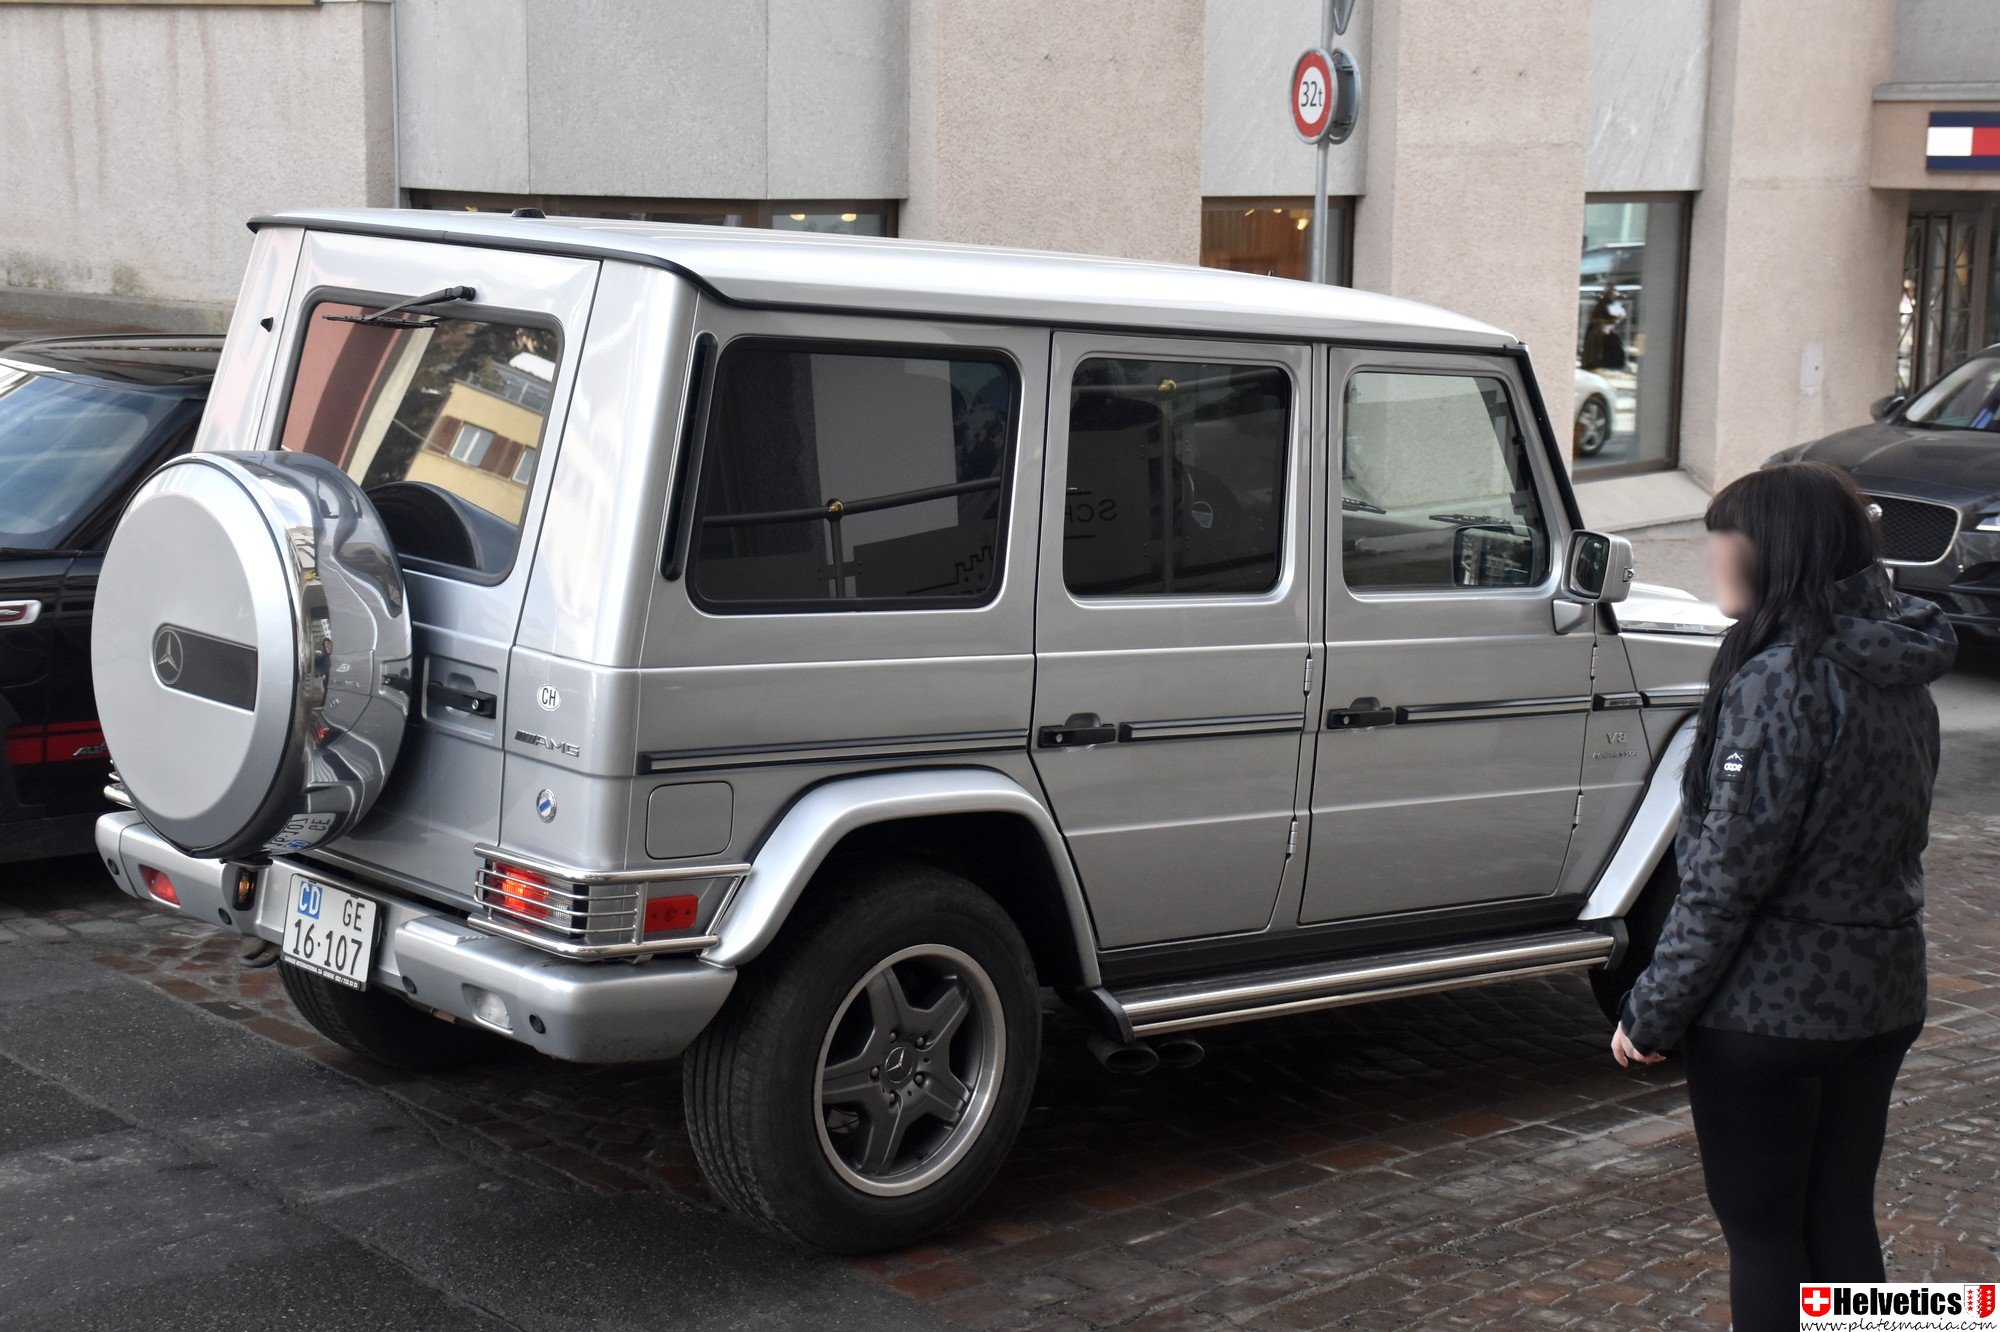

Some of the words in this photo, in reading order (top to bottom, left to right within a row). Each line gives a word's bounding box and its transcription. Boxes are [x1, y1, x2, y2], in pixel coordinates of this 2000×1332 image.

[1301, 81, 1323, 107] 32t
[541, 687, 557, 706] CH
[533, 734, 580, 758] AMG
[1606, 732, 1627, 744] V8
[299, 882, 321, 916] CD
[343, 899, 366, 932] GE
